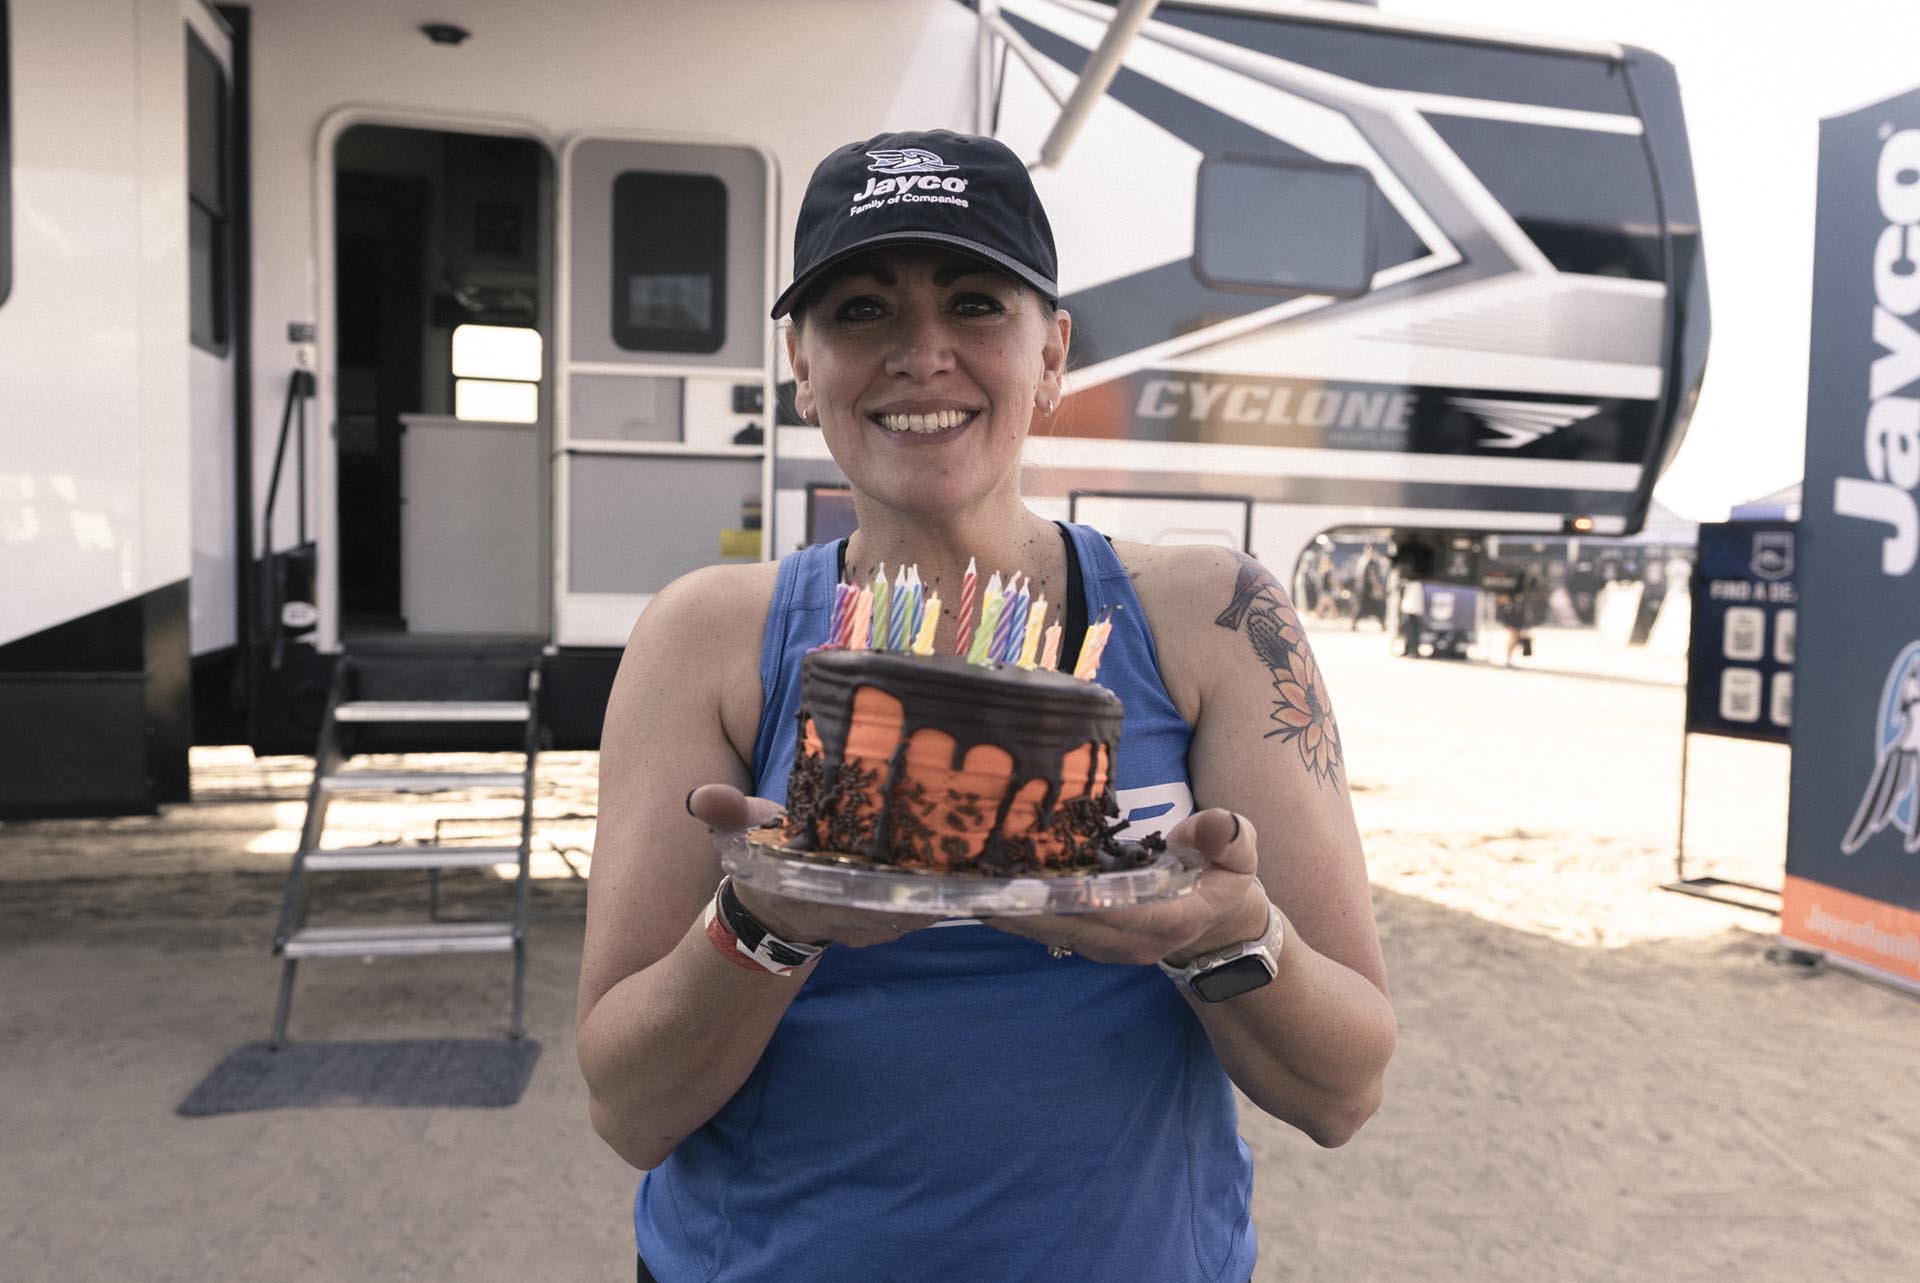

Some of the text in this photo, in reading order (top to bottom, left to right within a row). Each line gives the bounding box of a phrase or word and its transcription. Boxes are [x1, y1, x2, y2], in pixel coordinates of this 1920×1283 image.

[849, 193, 969, 217] Family of Companies
[853, 175, 966, 202] Jayco
[1833, 127, 1920, 577] Jayco
[1135, 379, 1420, 431] CYCLONE
